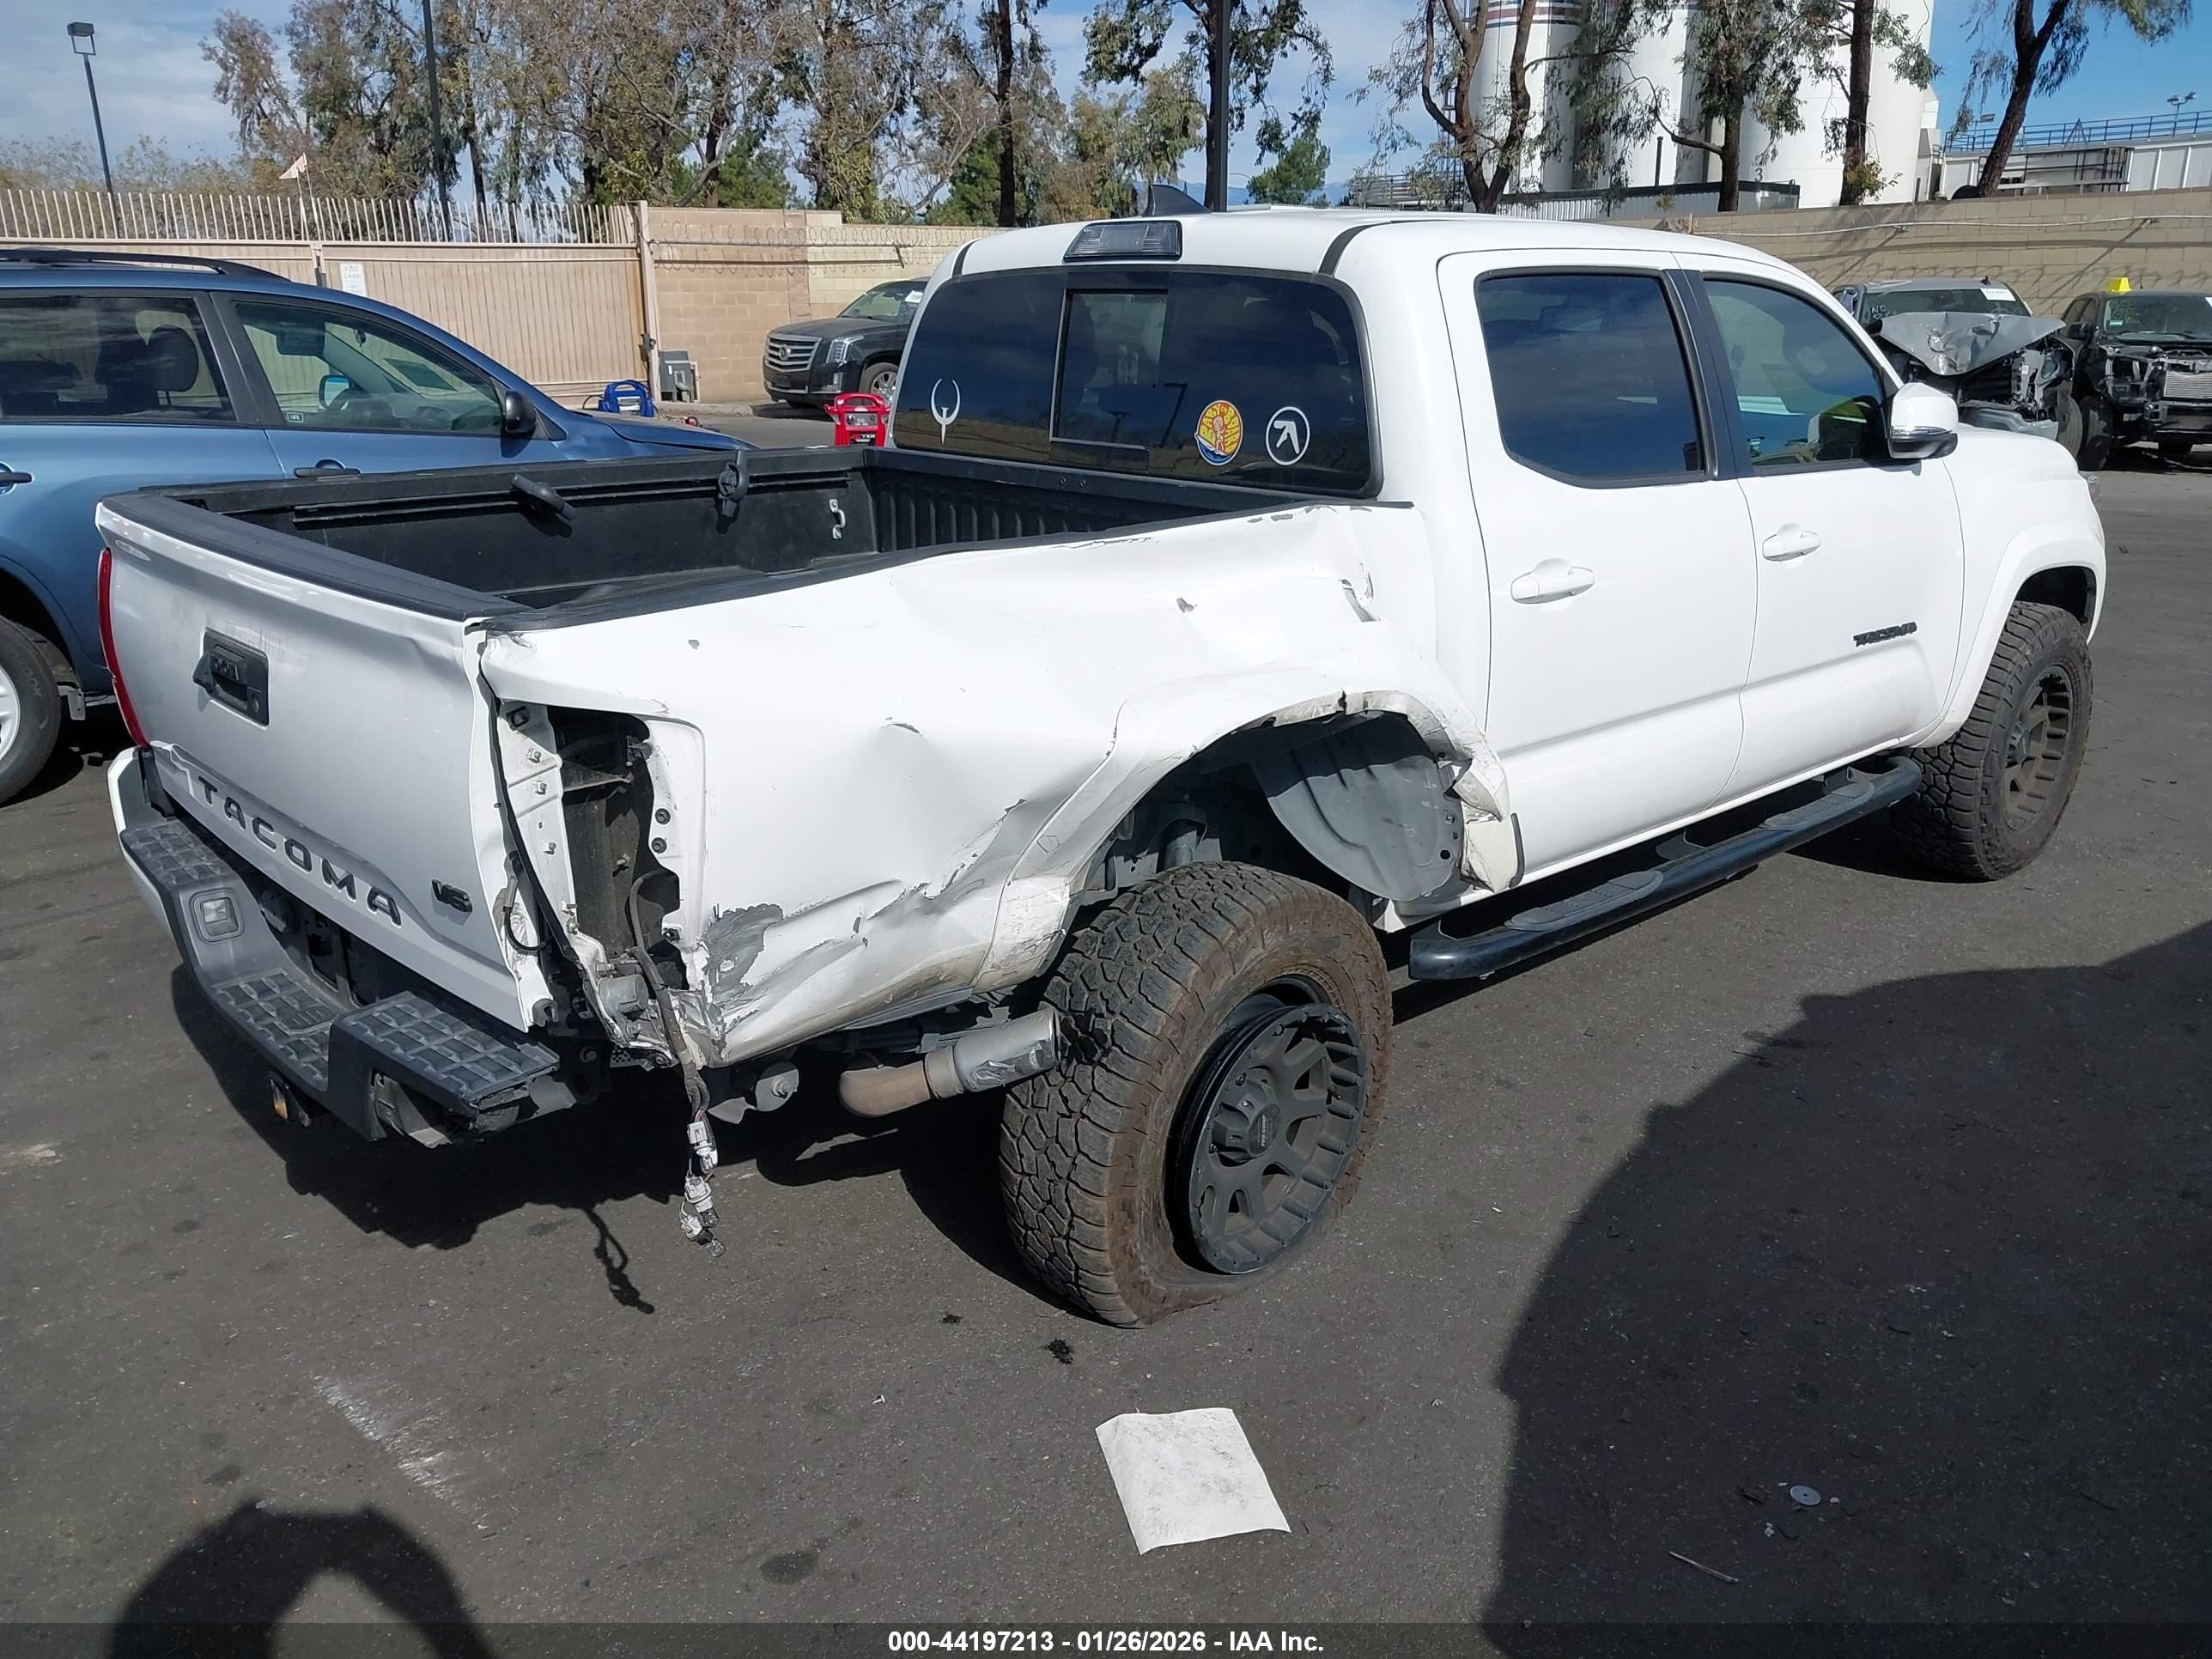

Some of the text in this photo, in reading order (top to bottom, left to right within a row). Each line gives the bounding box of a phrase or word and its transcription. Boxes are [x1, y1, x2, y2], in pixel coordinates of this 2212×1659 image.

[1754, 167, 1764, 182] 3
[198, 775, 402, 927] TACOMA
[431, 879, 473, 913] V6
